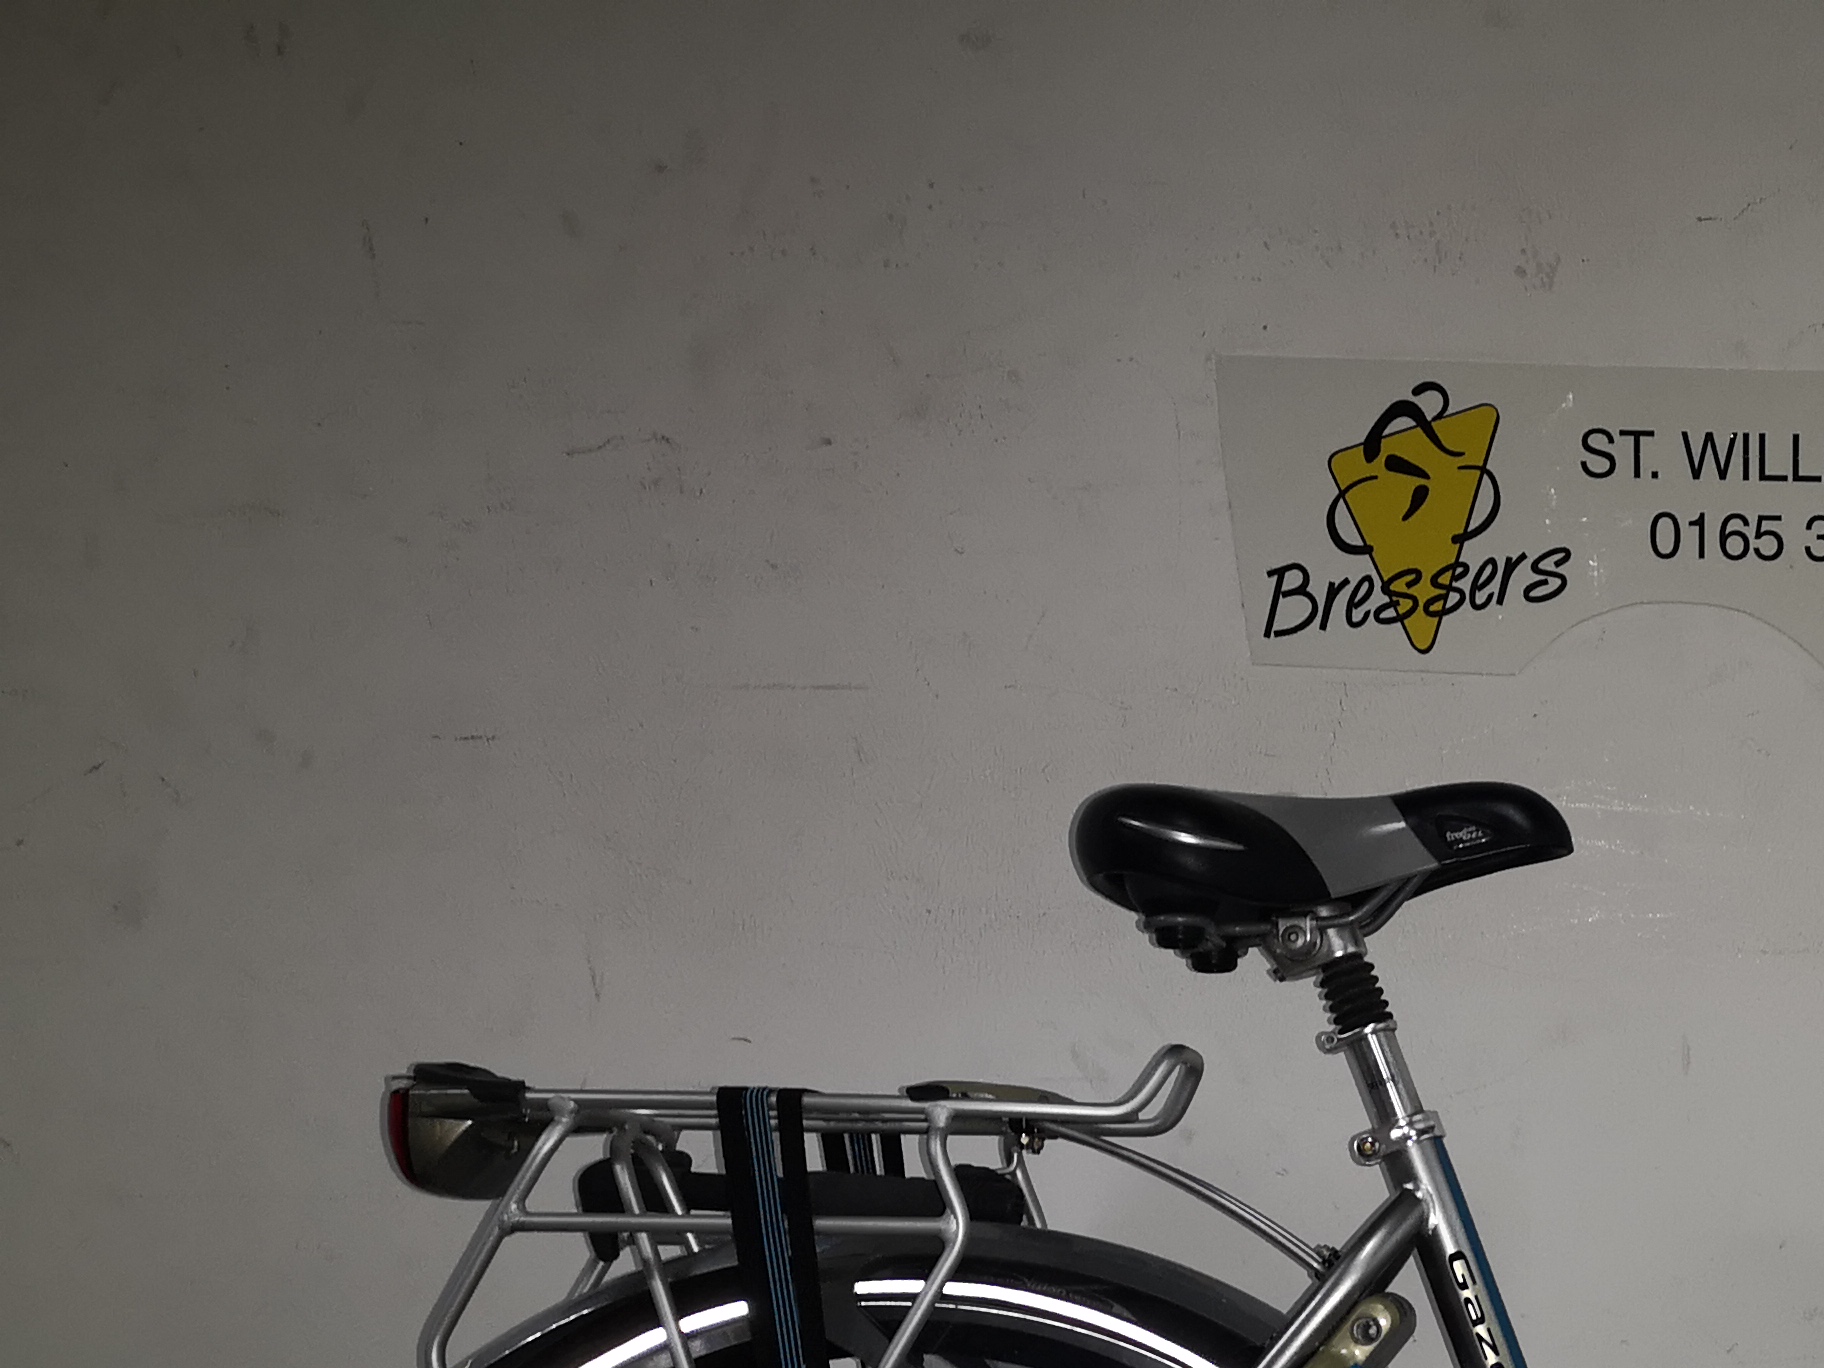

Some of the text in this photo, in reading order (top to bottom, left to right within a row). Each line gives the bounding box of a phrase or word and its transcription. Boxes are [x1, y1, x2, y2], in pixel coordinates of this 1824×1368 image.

[1580, 427, 1660, 481] ST.
[1648, 512, 1785, 562] 0165
[1263, 546, 1572, 638] Bressers
